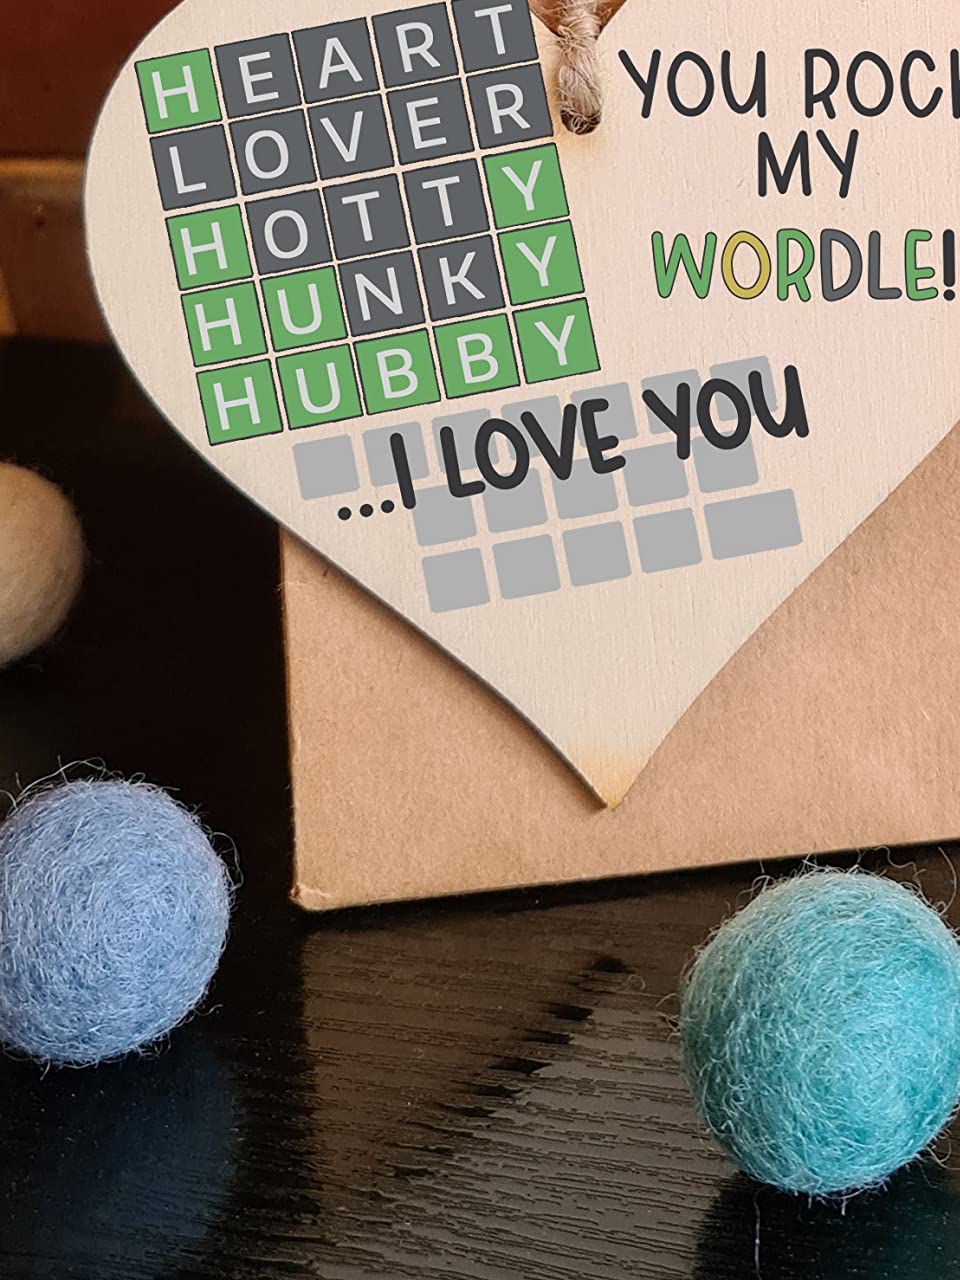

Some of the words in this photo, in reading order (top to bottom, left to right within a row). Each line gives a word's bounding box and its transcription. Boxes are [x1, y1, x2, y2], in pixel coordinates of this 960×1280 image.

[150, 3, 513, 120] HEART
[618, 49, 767, 118] YOU
[168, 83, 530, 194] LOVER
[758, 129, 859, 198] MY
[180, 160, 543, 276] HOTTY
[651, 228, 956, 302] WORDLE!
[195, 235, 558, 352] HUNKY
[213, 315, 576, 430] HUBBY
[440, 398, 626, 498] LOVE
[642, 365, 810, 460] YOU
